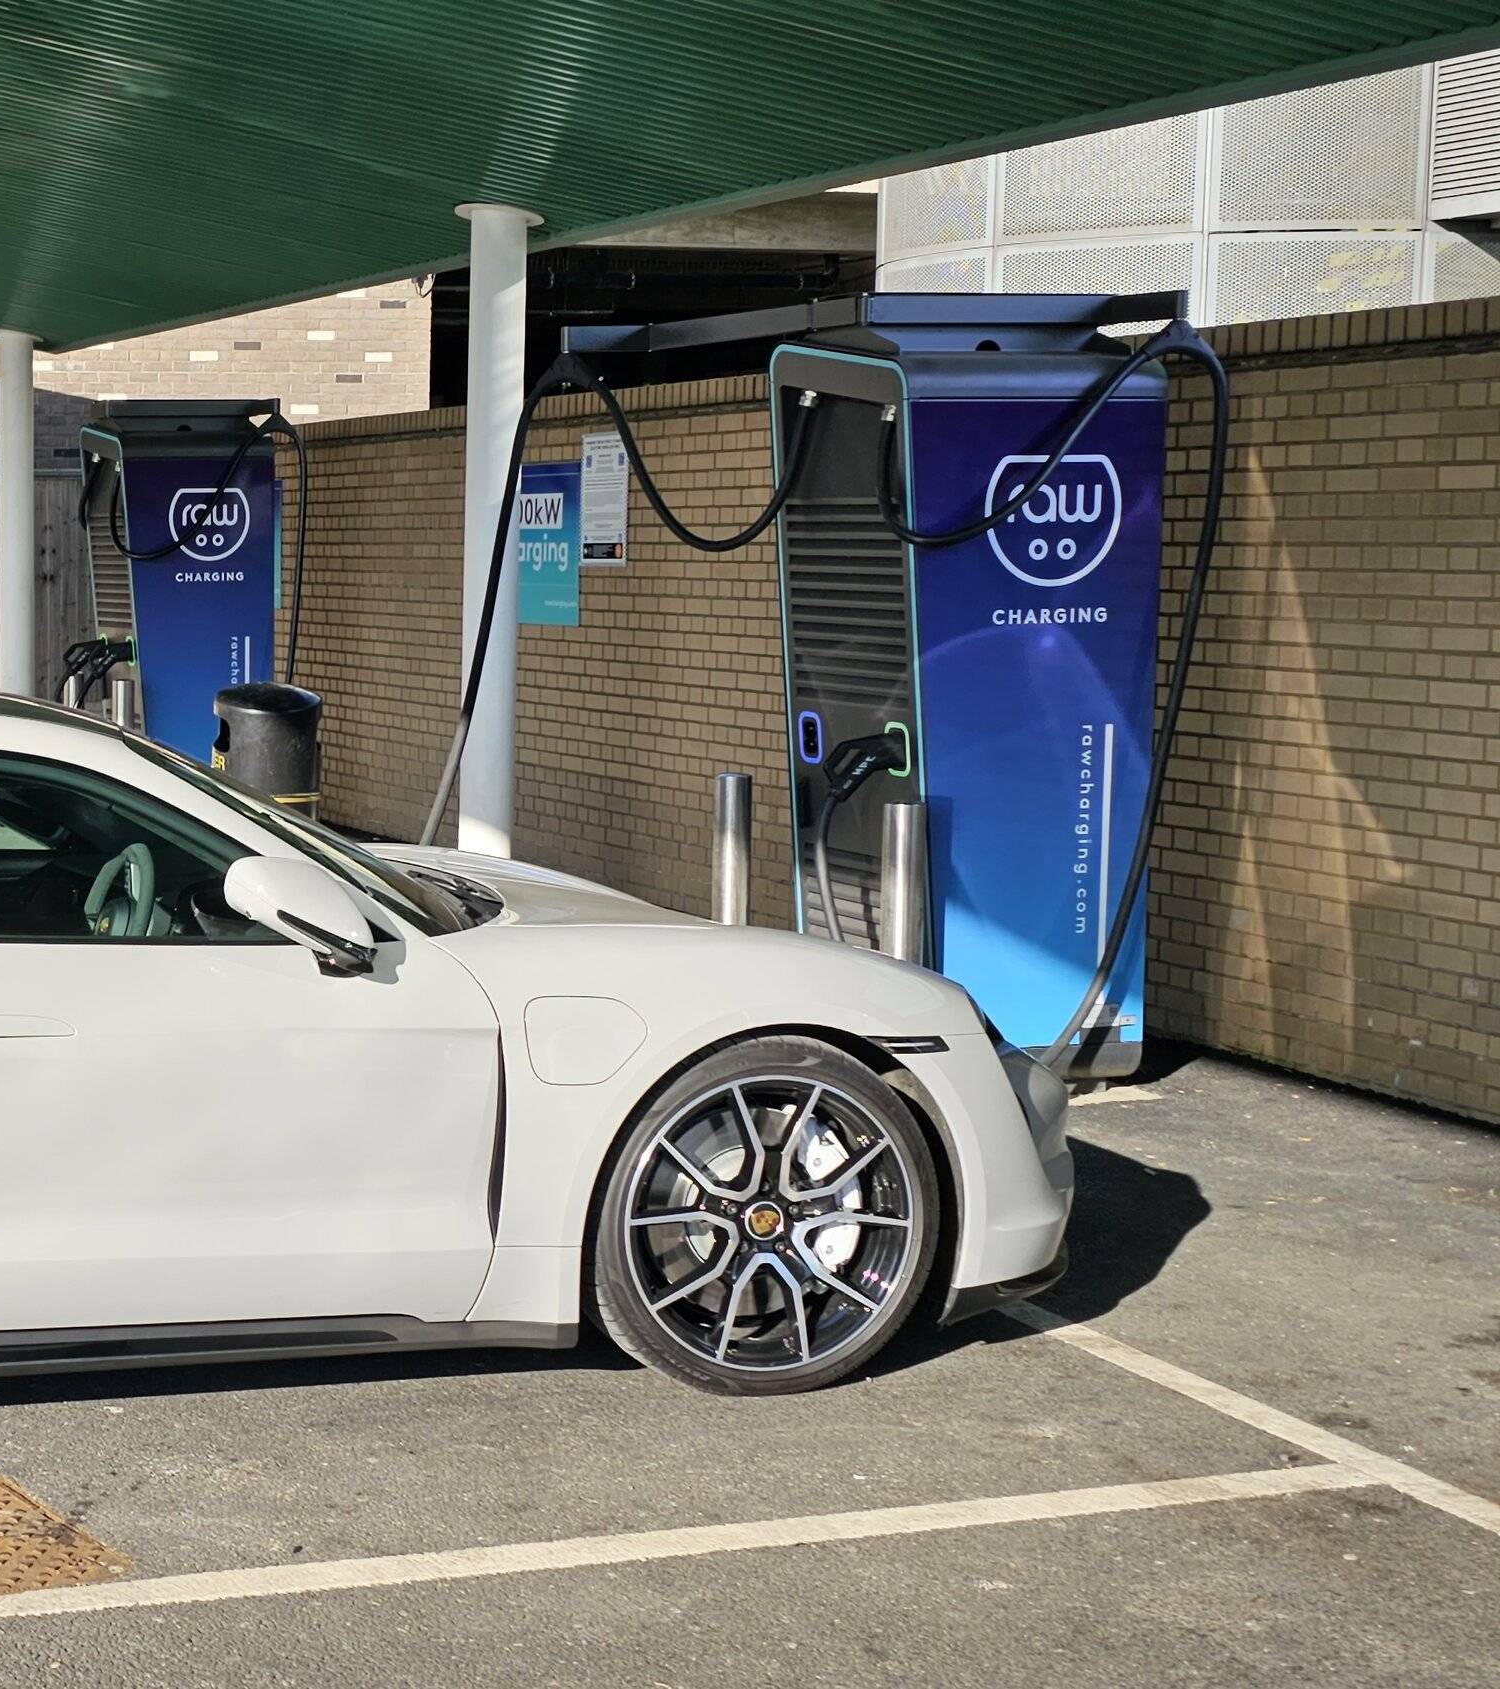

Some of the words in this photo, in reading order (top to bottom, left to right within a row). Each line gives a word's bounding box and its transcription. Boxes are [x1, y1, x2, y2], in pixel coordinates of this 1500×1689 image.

[182, 504, 238, 526] raw
[1007, 484, 1102, 523] raw
[518, 533, 568, 571] arging
[175, 572, 244, 582] CHARGING
[992, 607, 1108, 625] CHARGING
[231, 636, 240, 684] rawcha
[1074, 724, 1094, 933] rawcharging.com
